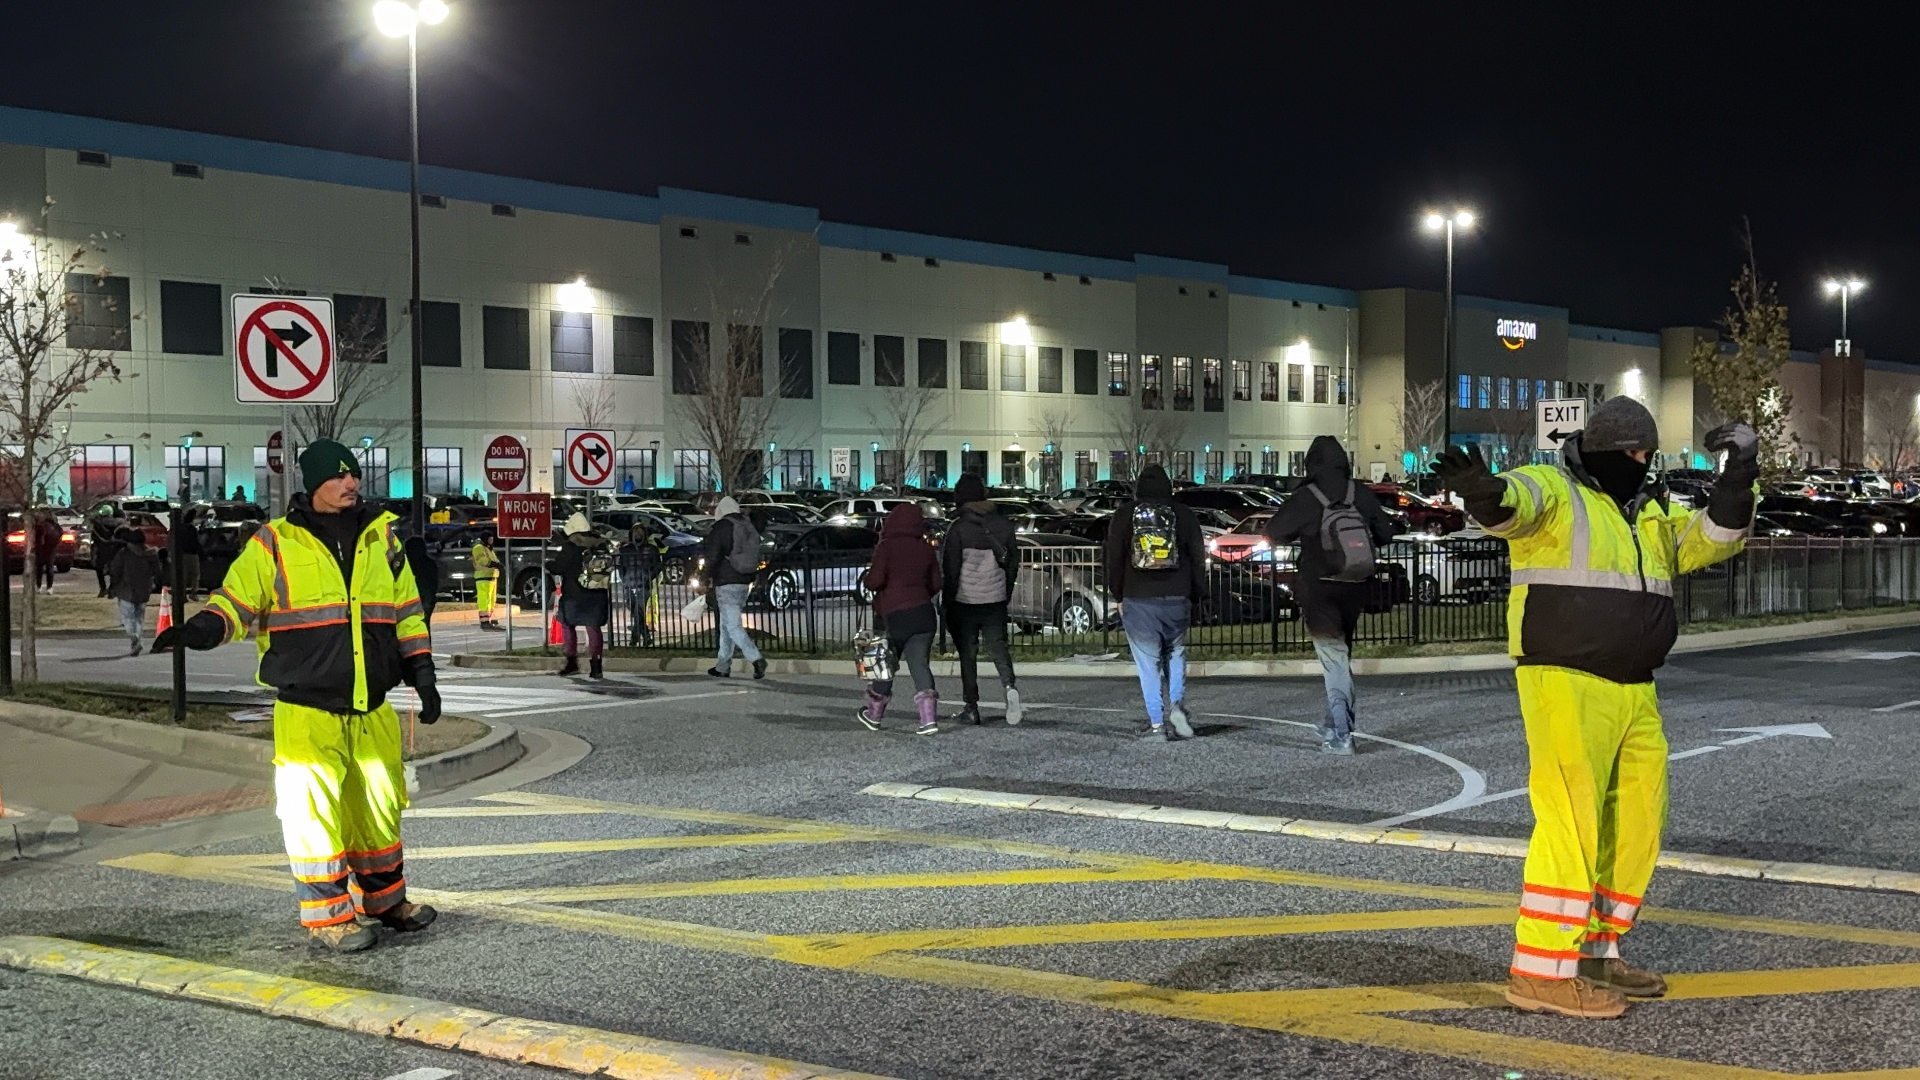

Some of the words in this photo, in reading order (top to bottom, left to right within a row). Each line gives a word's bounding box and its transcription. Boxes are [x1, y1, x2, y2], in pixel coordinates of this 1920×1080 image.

[1497, 319, 1536, 340] amazon
[1544, 406, 1580, 422] EXIT
[491, 447, 502, 456] DO
[505, 447, 520, 456] NOT
[836, 463, 846, 474] 10
[491, 471, 519, 481] ENTER
[503, 500, 546, 513] WRONG
[512, 517, 537, 531] WAY
